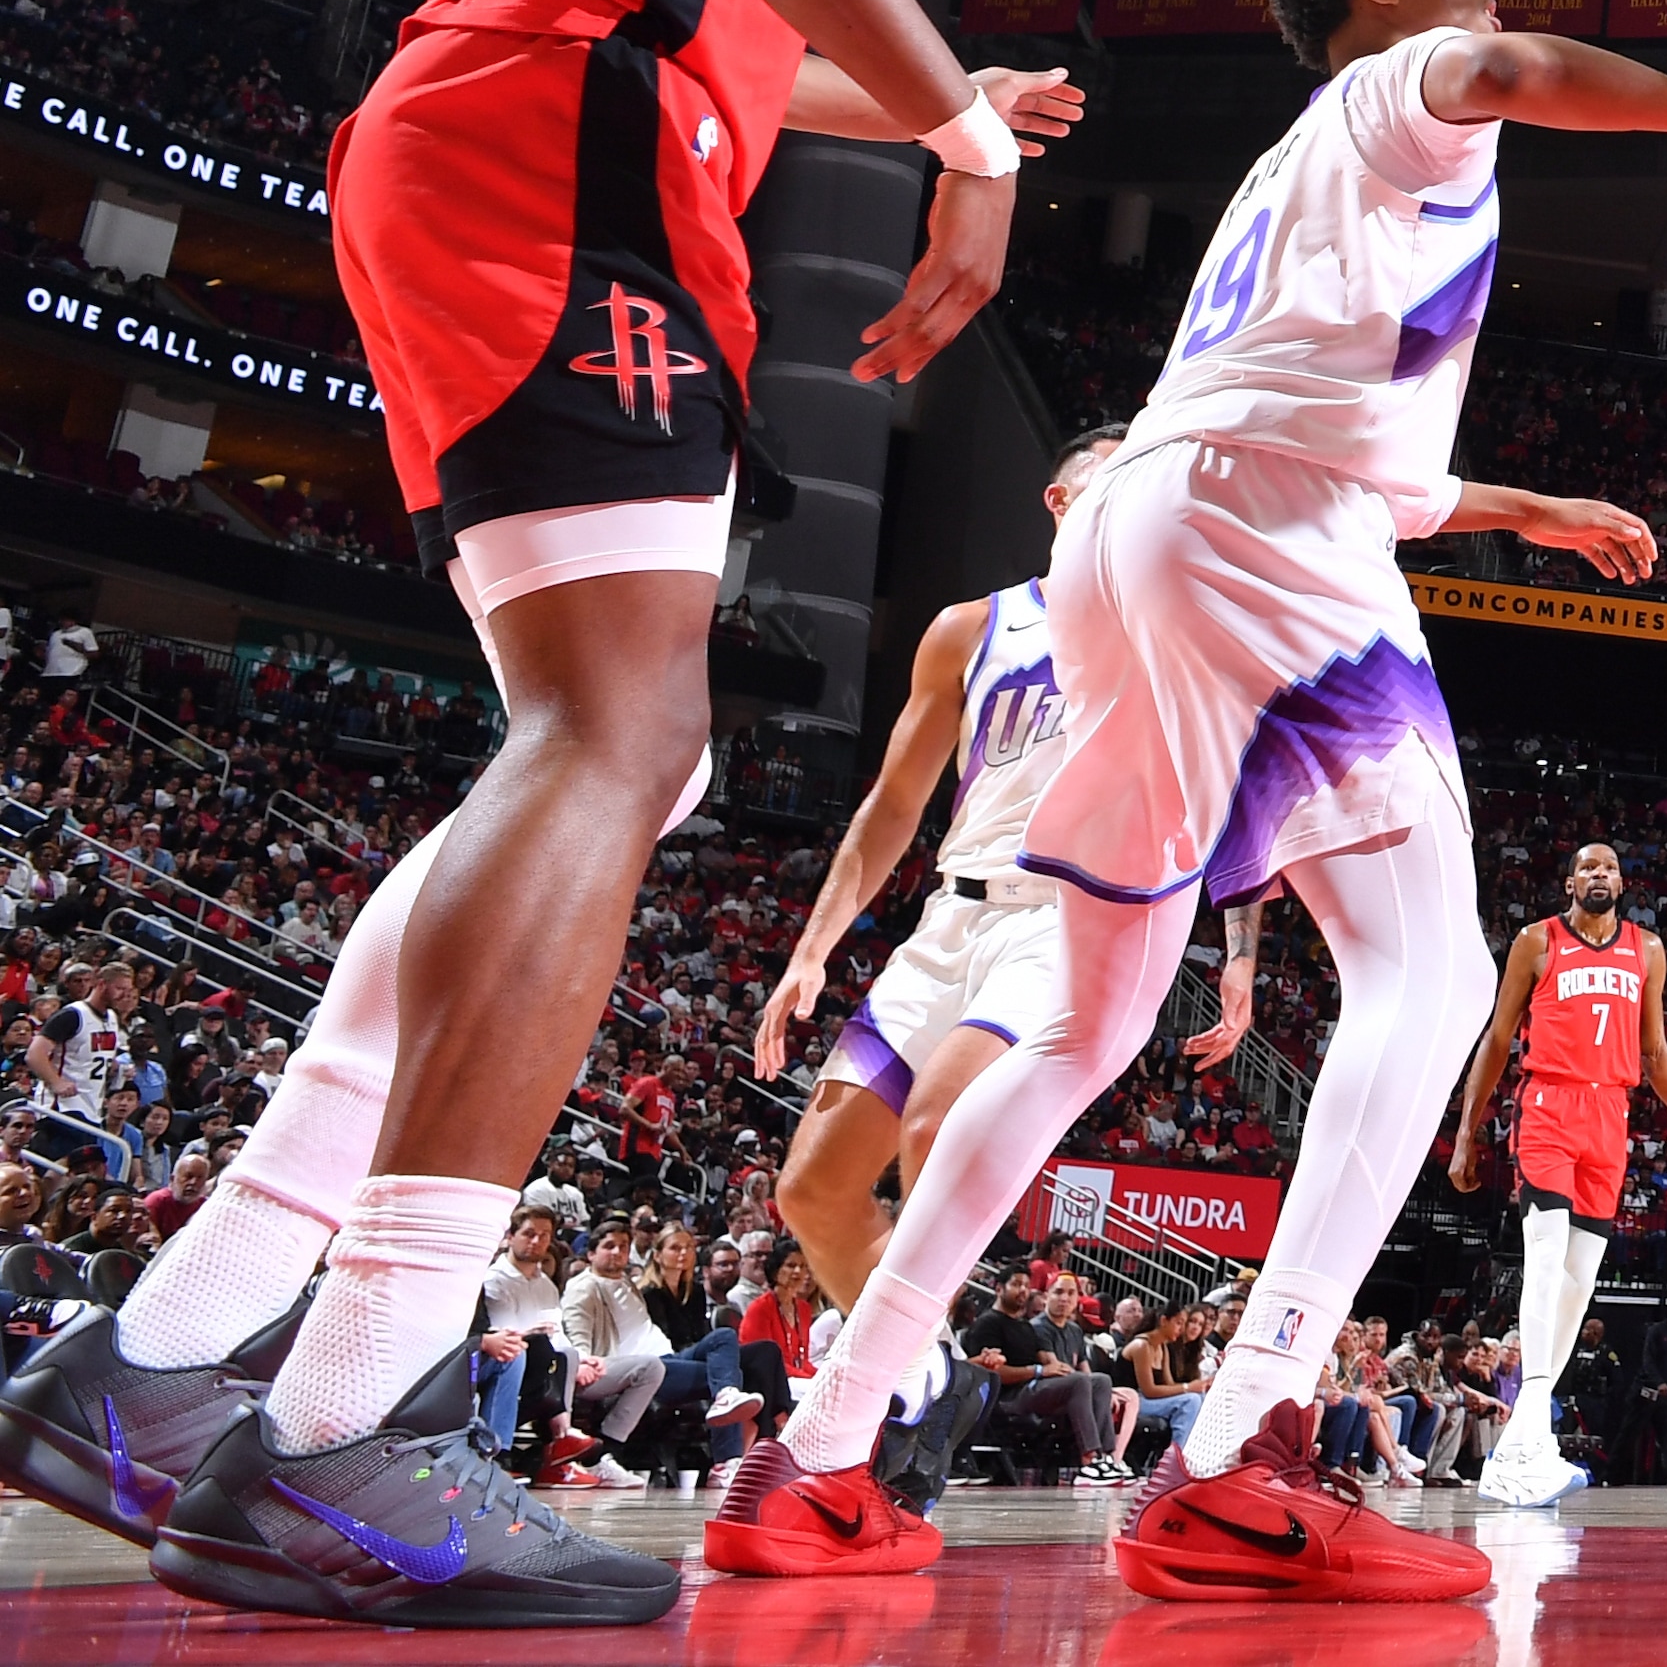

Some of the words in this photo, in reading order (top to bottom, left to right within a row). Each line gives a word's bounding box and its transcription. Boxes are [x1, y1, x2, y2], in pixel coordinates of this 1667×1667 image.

[1525, 12, 1552, 27] 2004
[43, 99, 143, 156] CALL.
[164, 145, 240, 188] ONE
[28, 288, 101, 330] ONE
[118, 318, 211, 367] CALL.
[232, 354, 306, 392] ONE
[1555, 965, 1641, 1004] ROCKETS
[1589, 1002, 1612, 1047] 7
[1122, 1188, 1247, 1234] TUNDRA
